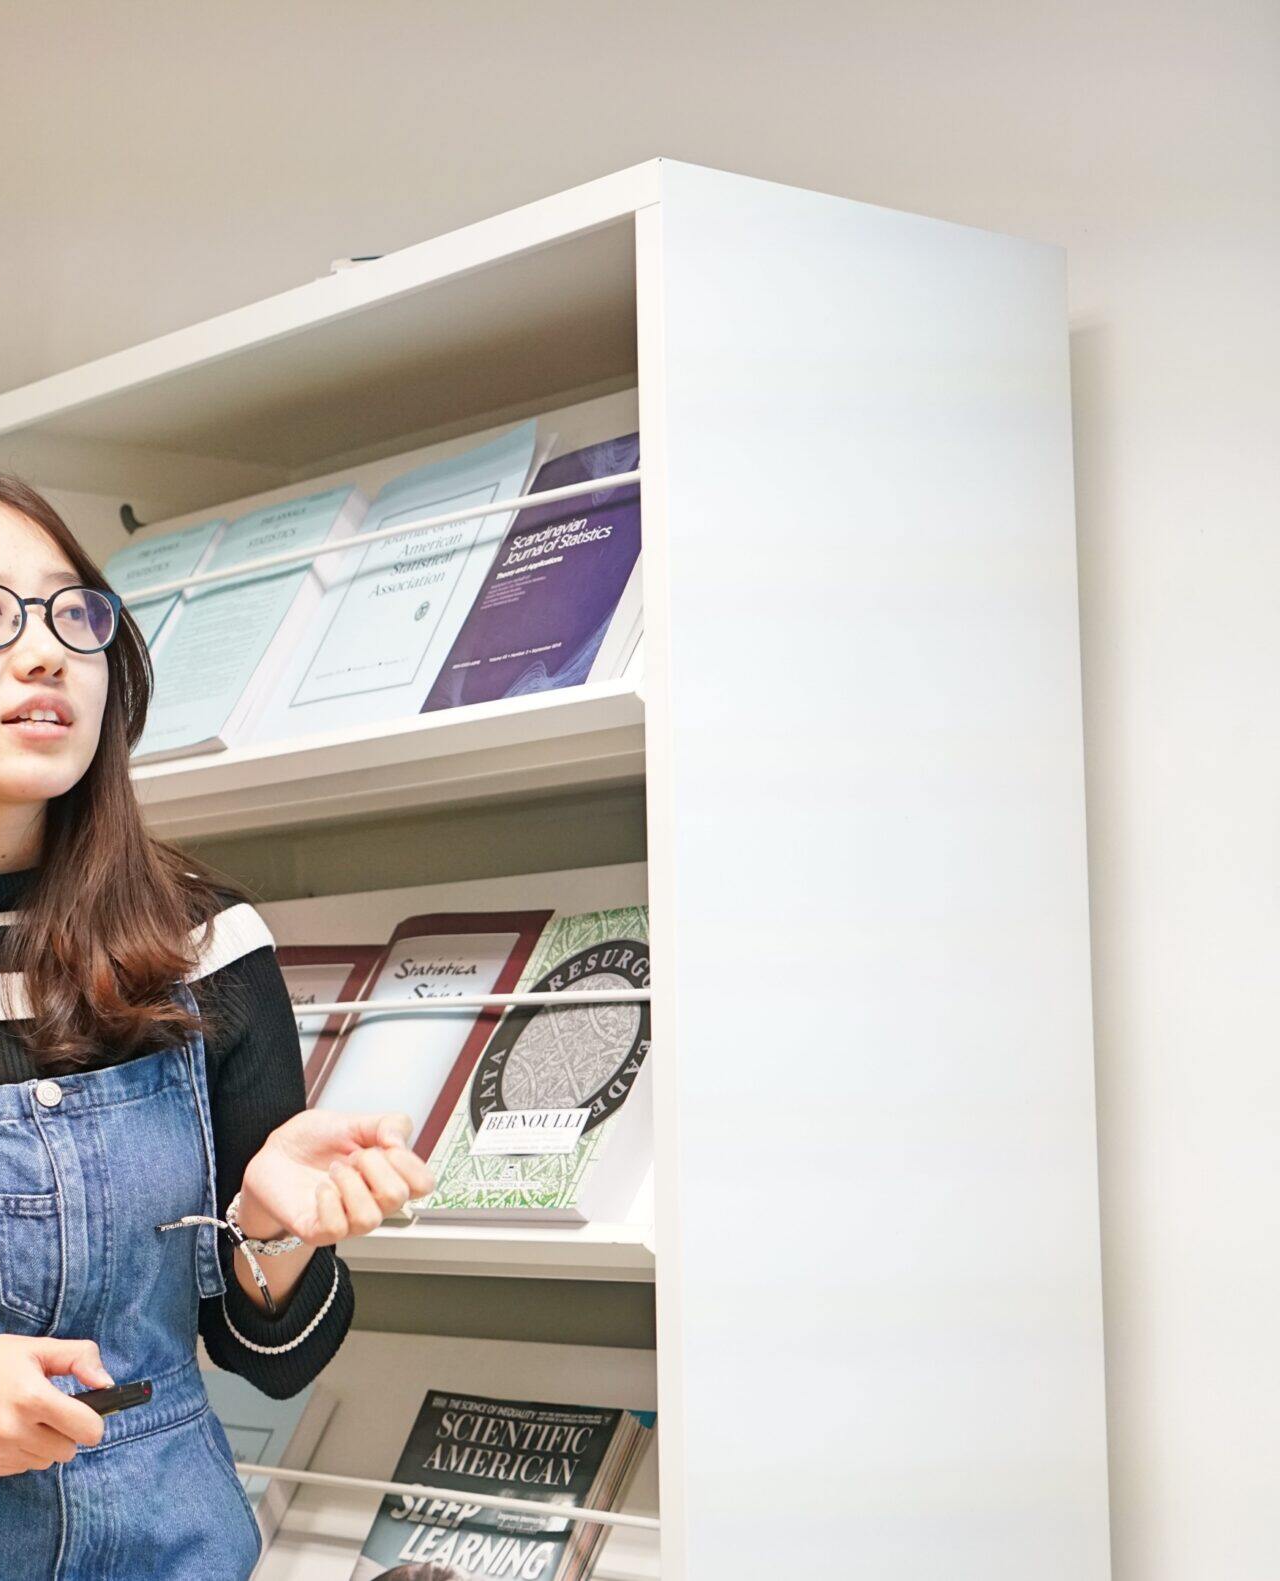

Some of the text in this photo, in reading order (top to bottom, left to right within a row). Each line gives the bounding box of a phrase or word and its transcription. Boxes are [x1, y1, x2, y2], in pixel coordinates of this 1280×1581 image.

[246, 527, 297, 549] STATISTICS
[398, 533, 463, 559] American
[502, 525, 613, 566] Journal of Statistics
[510, 518, 588, 550] Scandinavian
[391, 548, 457, 576] Statistical
[369, 571, 446, 598] Association
[394, 957, 478, 979] Statistica
[486, 1112, 583, 1130] BERNOULLI
[448, 1399, 461, 1411] THE
[461, 1400, 487, 1414] SCIENCE
[486, 1403, 498, 1416] OF
[497, 1405, 538, 1422] INEQUALITY
[435, 1411, 594, 1455] SCIENTIFIC
[422, 1443, 580, 1487] AMERICAN
[391, 1484, 482, 1529] SLEEP
[398, 1524, 557, 1580] LEARNING
